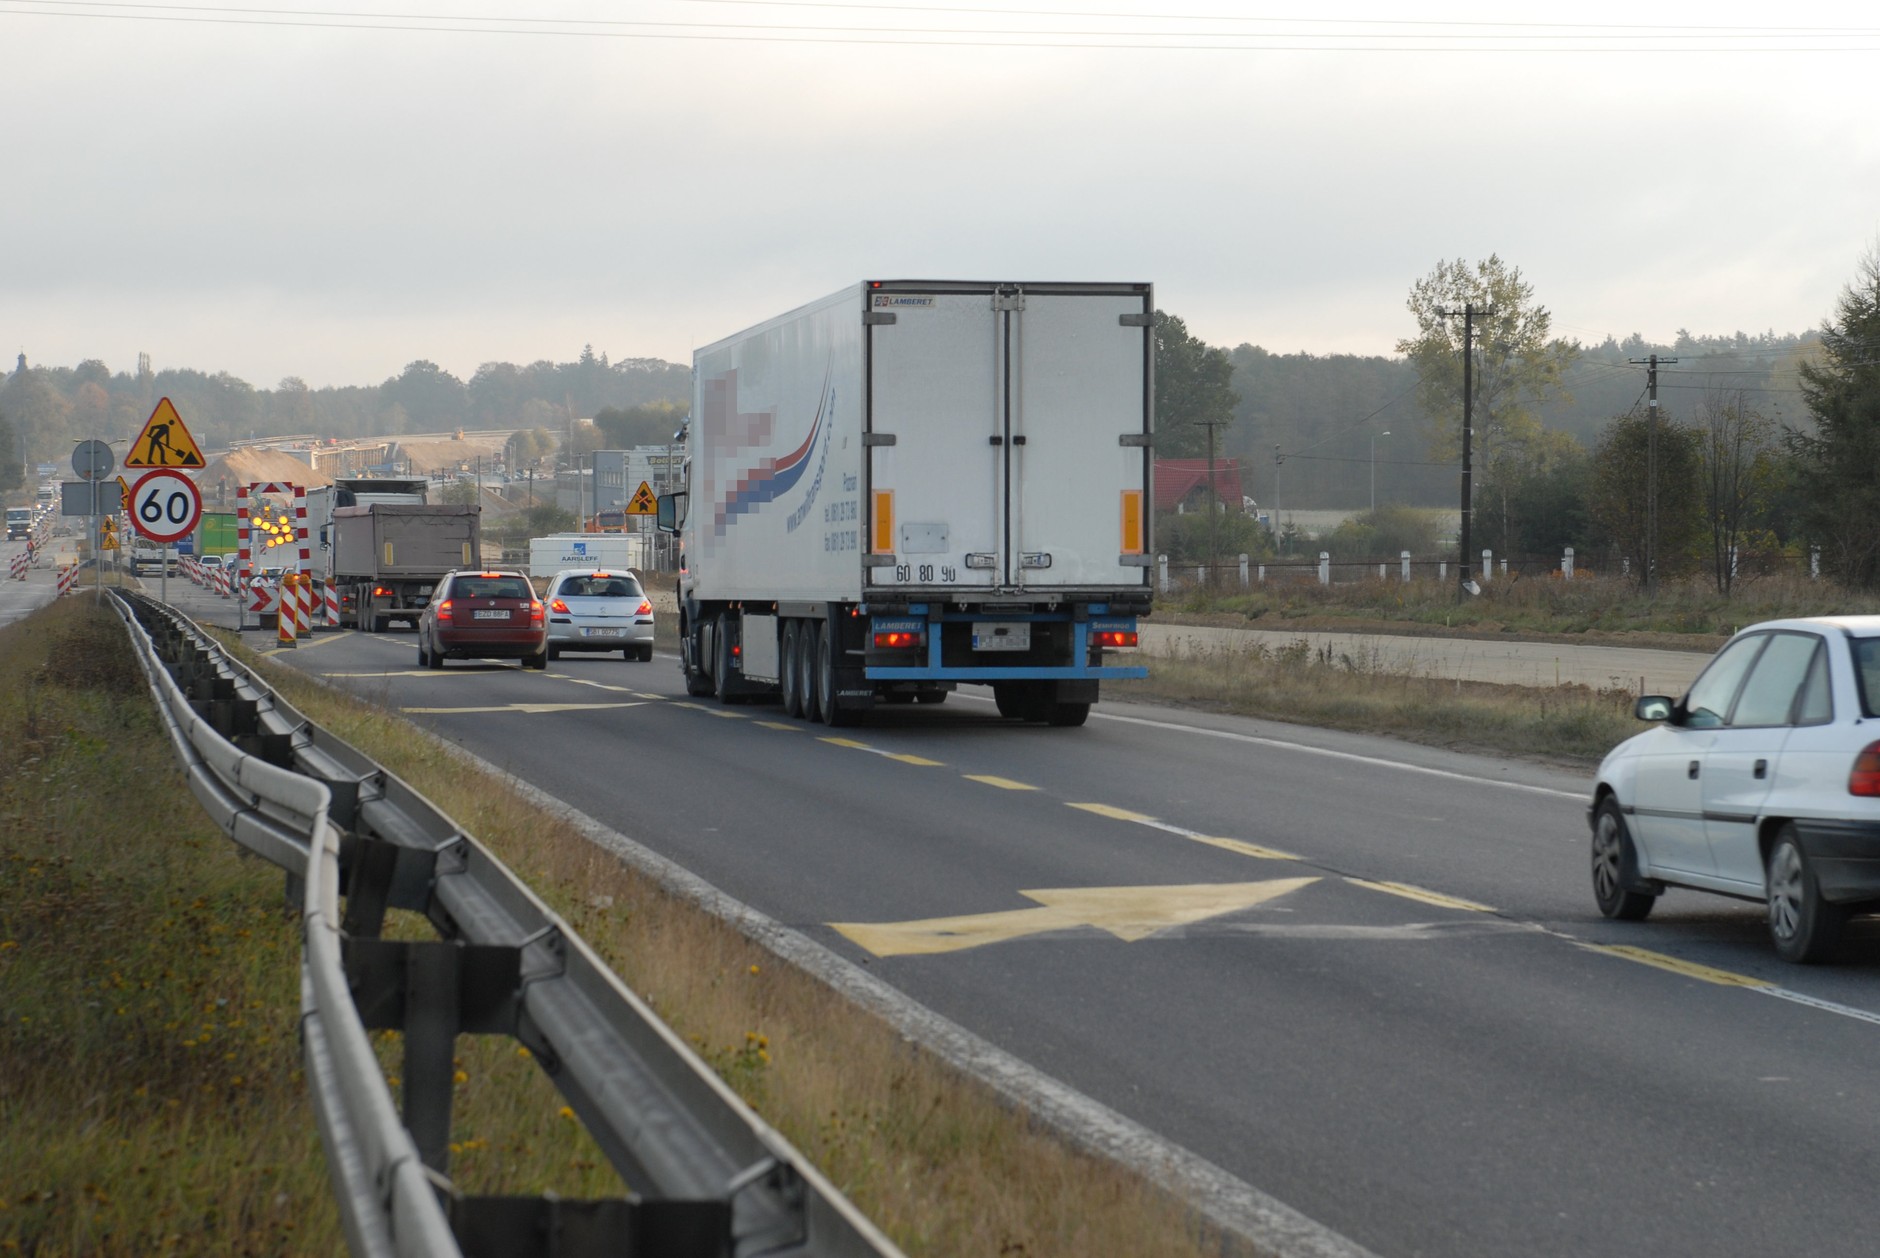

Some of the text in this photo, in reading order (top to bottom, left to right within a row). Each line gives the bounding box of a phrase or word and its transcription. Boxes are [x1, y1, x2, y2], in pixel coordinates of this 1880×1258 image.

[889, 298, 933, 306] LAMBERET
[140, 488, 190, 525] 60
[896, 564, 911, 582] 60
[919, 564, 934, 582] 80
[874, 621, 922, 630] LAMBERET
